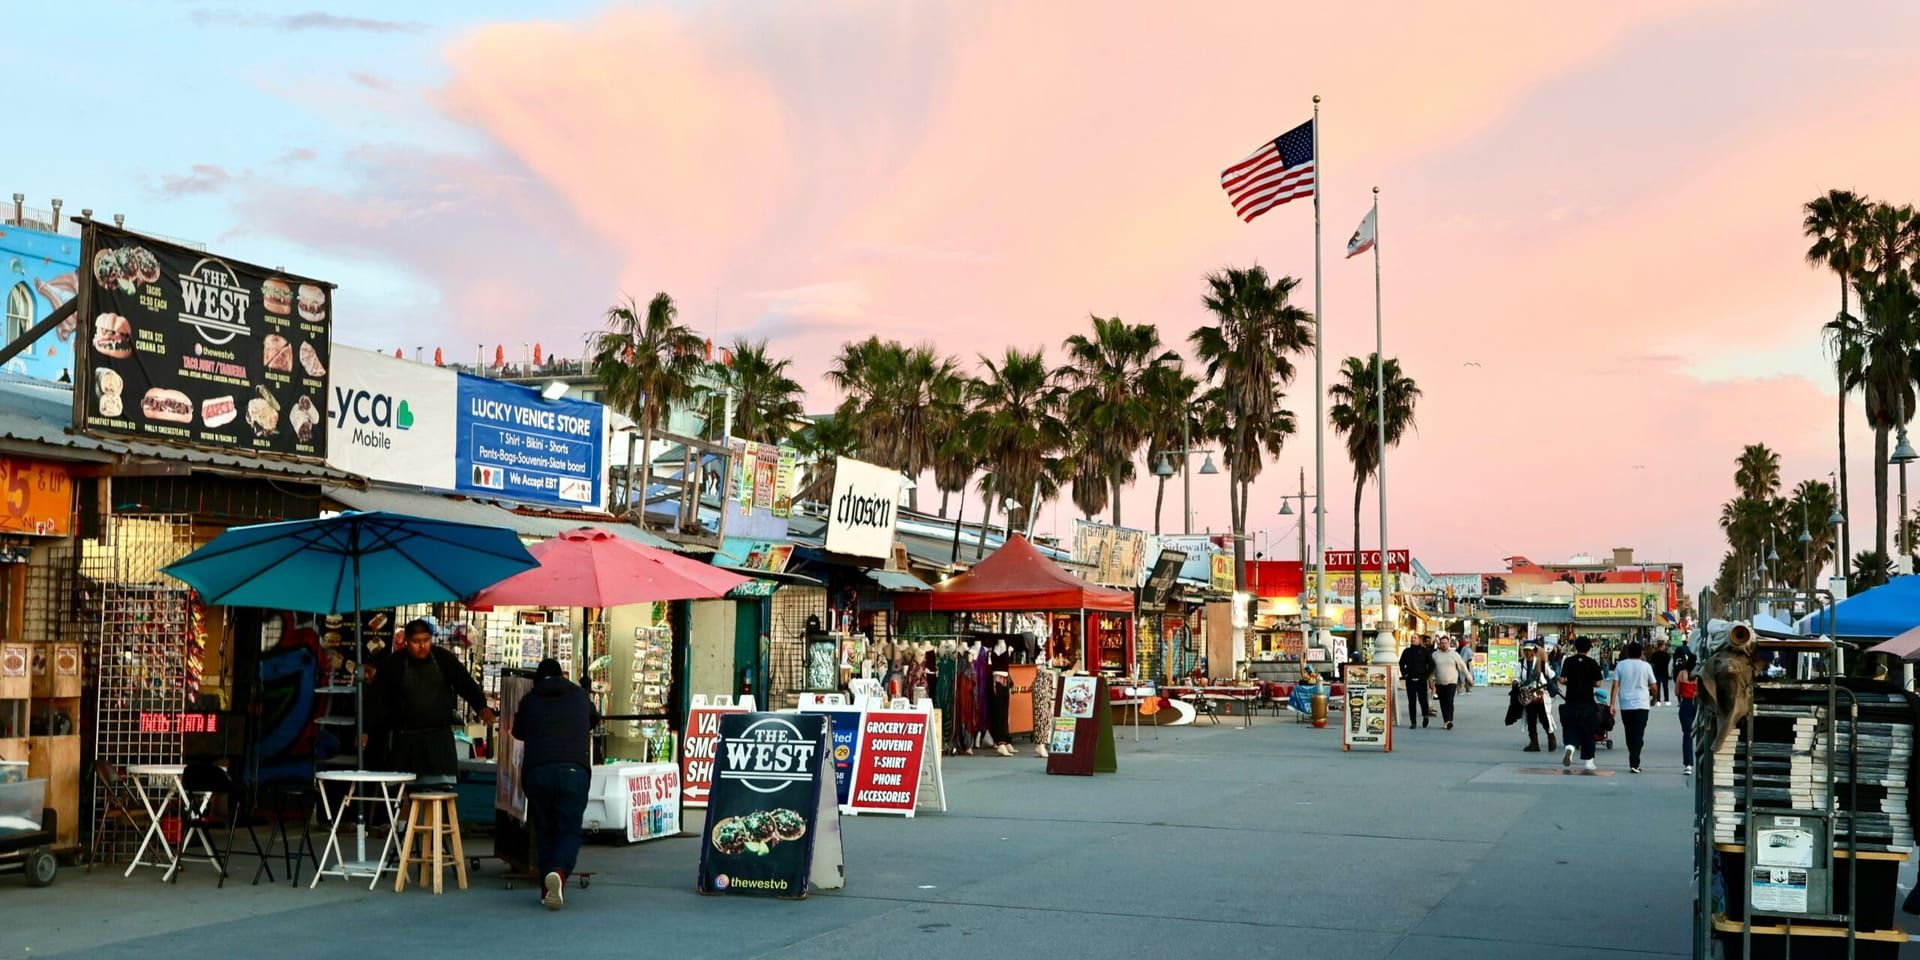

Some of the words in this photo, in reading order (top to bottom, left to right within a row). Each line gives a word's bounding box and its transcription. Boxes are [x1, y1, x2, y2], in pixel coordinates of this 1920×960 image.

[201, 268, 228, 288] THE
[146, 285, 162, 297] TACOS
[154, 298, 168, 310] EACH
[180, 280, 250, 324] WEST
[138, 330, 154, 342] TORTA
[136, 340, 156, 352] CUBANA
[203, 346, 234, 360] thewestvb
[472, 398, 512, 422] LUCKY
[514, 405, 555, 430] VENICE
[557, 414, 591, 436] STORE
[352, 428, 391, 450] Mobile
[499, 432, 504, 444] T
[505, 433, 520, 446] Shirt
[526, 436, 544, 450] Bikini
[550, 440, 568, 455] Shorts
[568, 460, 586, 473] board
[38, 470, 46, 492] &
[50, 471, 66, 493] UP
[510, 472, 521, 484] We
[522, 474, 544, 490] Accept
[545, 478, 558, 490] EBT
[838, 481, 891, 531] chosen
[1323, 552, 1368, 566] ETTE
[1371, 552, 1406, 564] CRN
[1579, 598, 1638, 608] SUNGLASS
[866, 722, 924, 735] GROCERY/EBT
[754, 730, 788, 743] THE
[871, 739, 914, 752] SOUVENIR
[726, 742, 814, 772] WEST
[874, 756, 906, 768] T-SHIRT
[628, 776, 652, 792] WATER
[872, 773, 902, 786] PHONE
[632, 791, 651, 807] SODA
[857, 790, 910, 803] ACCESSORIES
[730, 876, 788, 890] thewestvb
